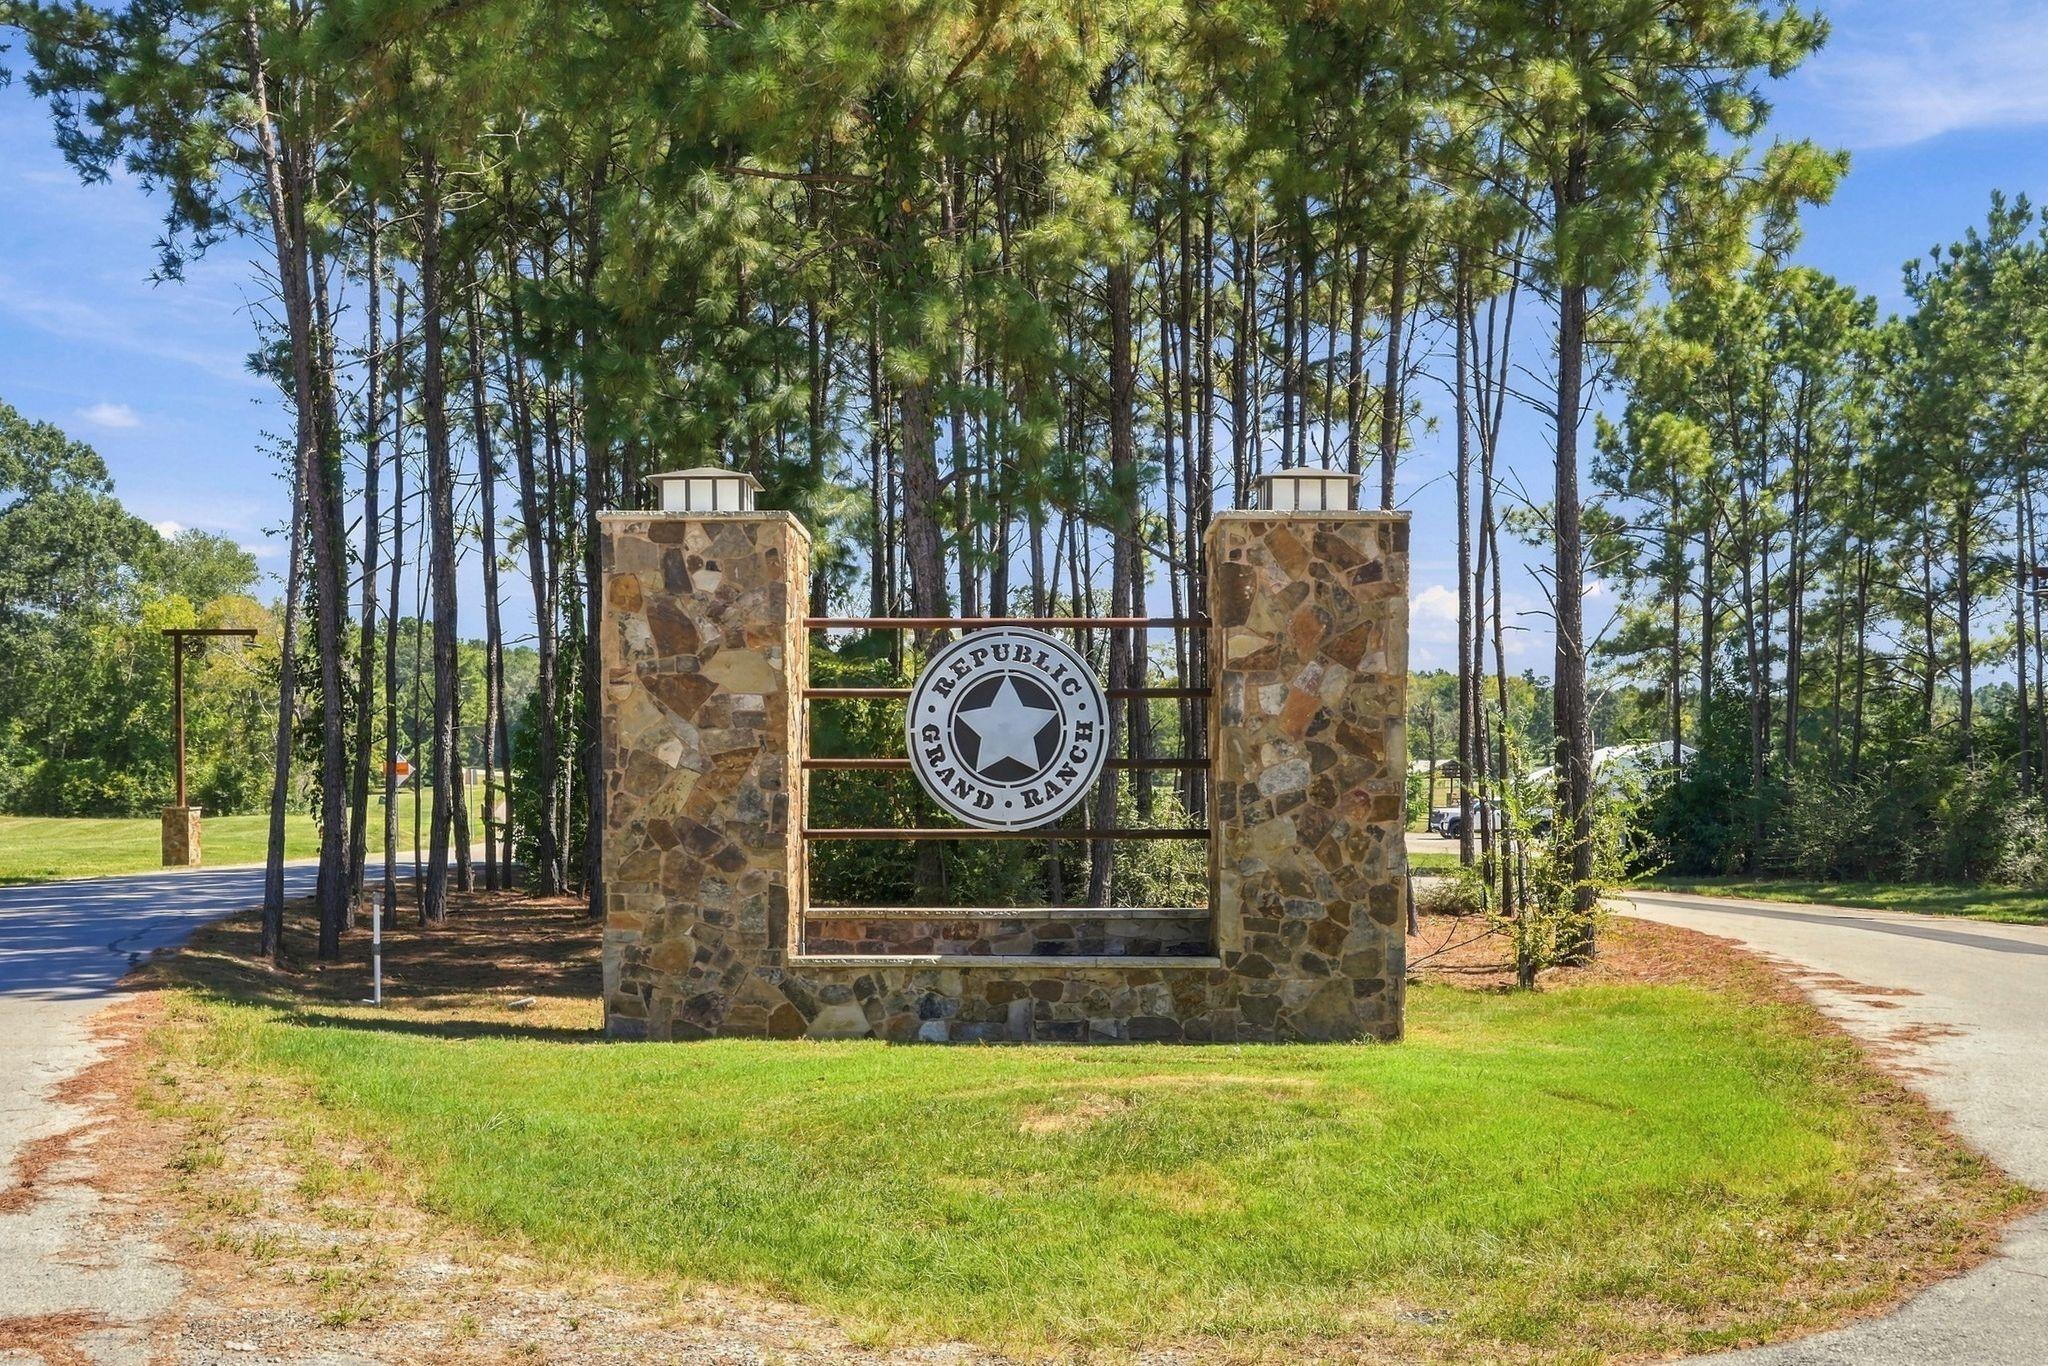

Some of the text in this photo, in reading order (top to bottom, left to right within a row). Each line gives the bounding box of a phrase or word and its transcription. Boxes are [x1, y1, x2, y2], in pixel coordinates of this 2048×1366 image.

[932, 644, 1082, 699] REPUBLIC
[921, 720, 1093, 809] GRAND RANCH
